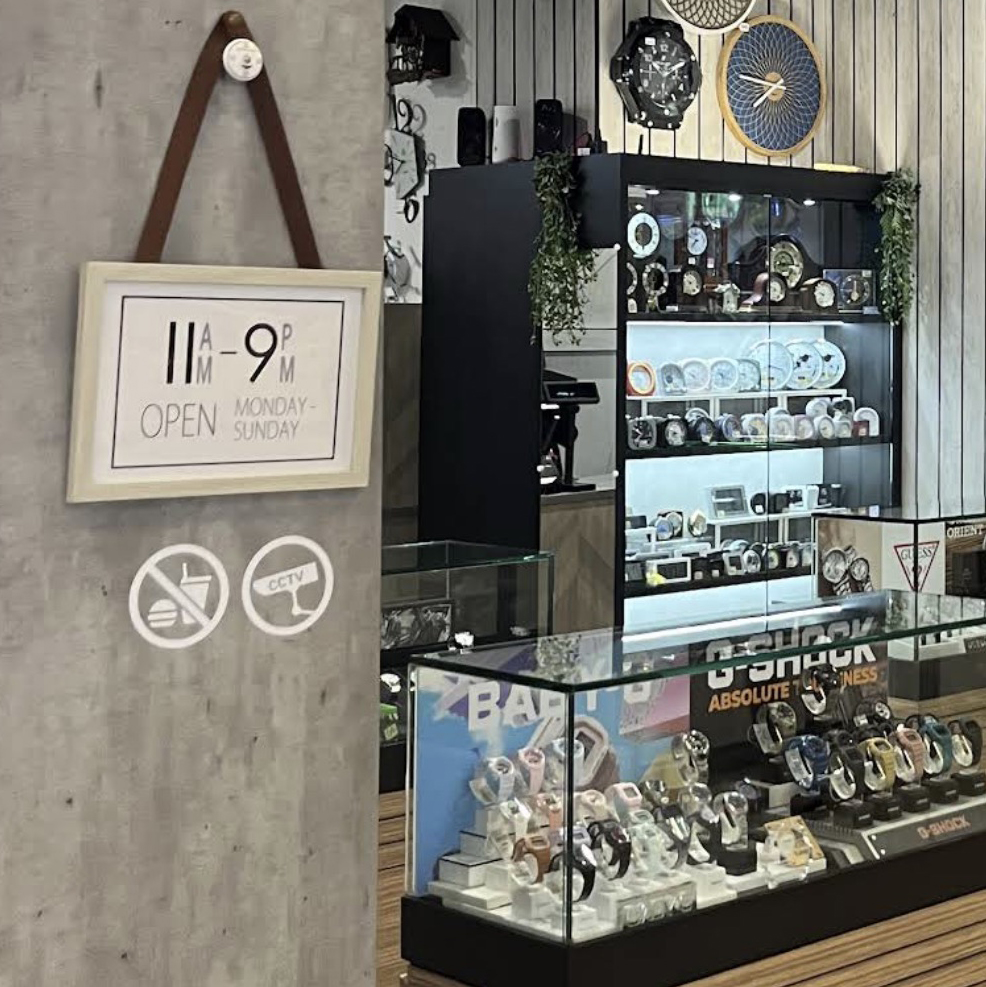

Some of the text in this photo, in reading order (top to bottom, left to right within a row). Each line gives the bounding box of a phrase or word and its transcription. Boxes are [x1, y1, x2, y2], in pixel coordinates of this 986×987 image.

[245, 323, 278, 382] 9
[140, 403, 217, 439] OPEN
[234, 420, 300, 442] SUNDAY
[946, 523, 985, 539] ORIENT
[268, 571, 303, 591] CCTV
[706, 616, 877, 690] G-SHOCK
[708, 681, 790, 713] ABSOLUTE
